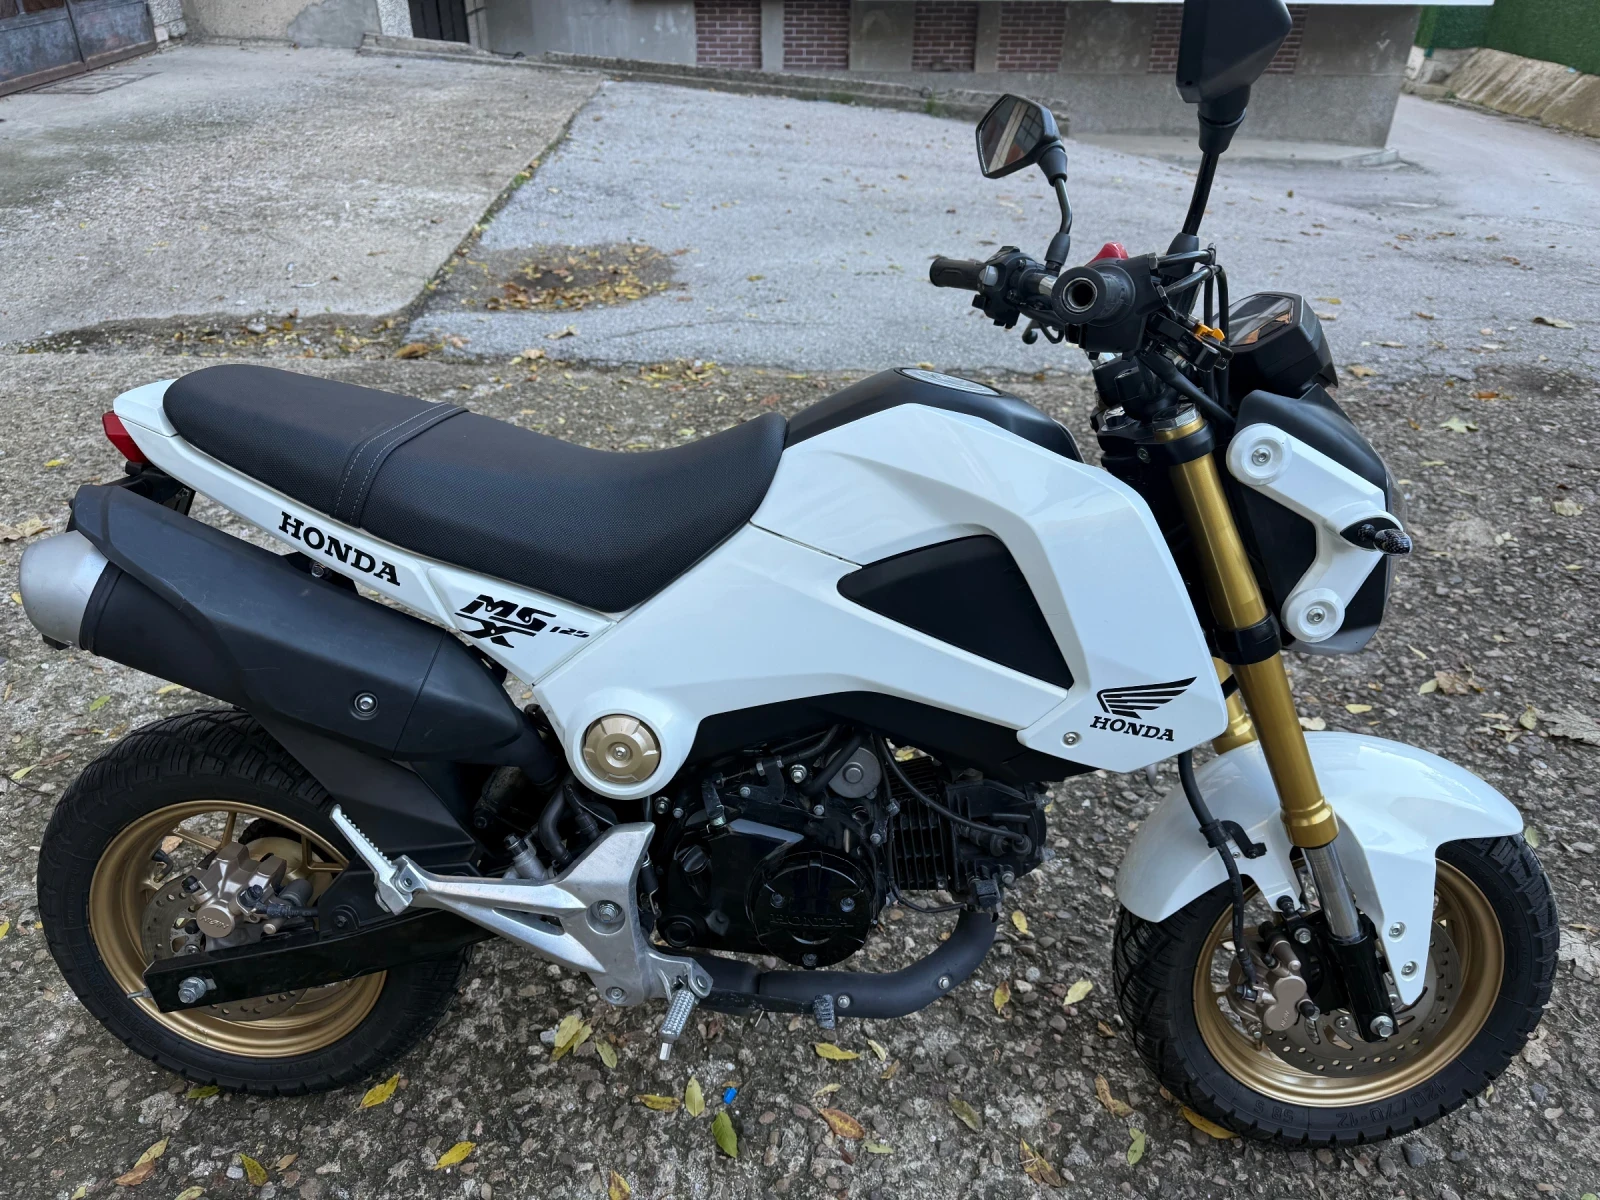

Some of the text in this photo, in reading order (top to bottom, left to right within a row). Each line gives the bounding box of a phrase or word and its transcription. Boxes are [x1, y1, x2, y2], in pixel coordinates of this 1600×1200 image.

[278, 511, 400, 586] HONDA
[550, 626, 590, 638] 125
[1090, 716, 1174, 741] HONDA
[769, 913, 854, 927] HONDA
[1253, 1100, 1294, 1123] 58 S
[1336, 1081, 1447, 1128] 120/70-12
